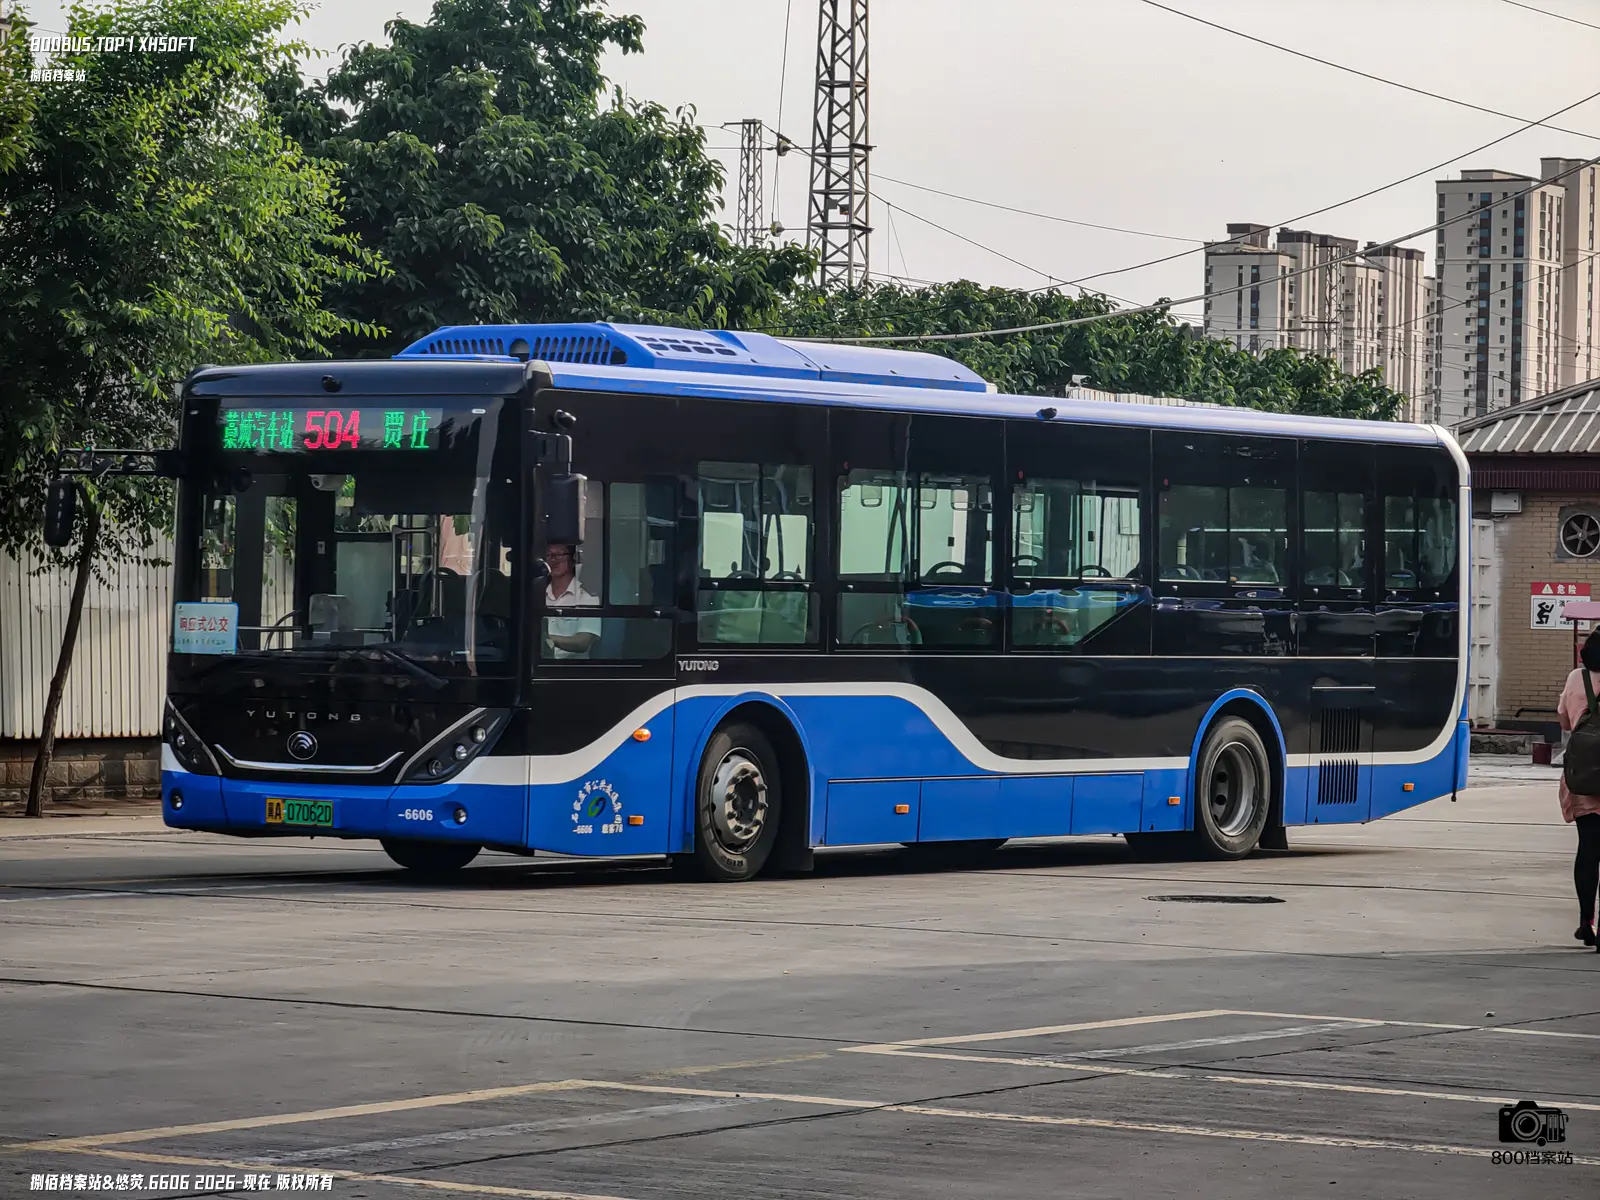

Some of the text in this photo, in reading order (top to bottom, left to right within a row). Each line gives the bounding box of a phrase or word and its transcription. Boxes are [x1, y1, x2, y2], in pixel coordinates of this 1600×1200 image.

[303, 410, 361, 449] 504
[383, 410, 432, 449] 贾庄
[1556, 584, 1577, 595] 危险
[677, 660, 720, 671] YUTONG
[246, 709, 361, 721] YUTONG
[397, 808, 434, 821] -6606
